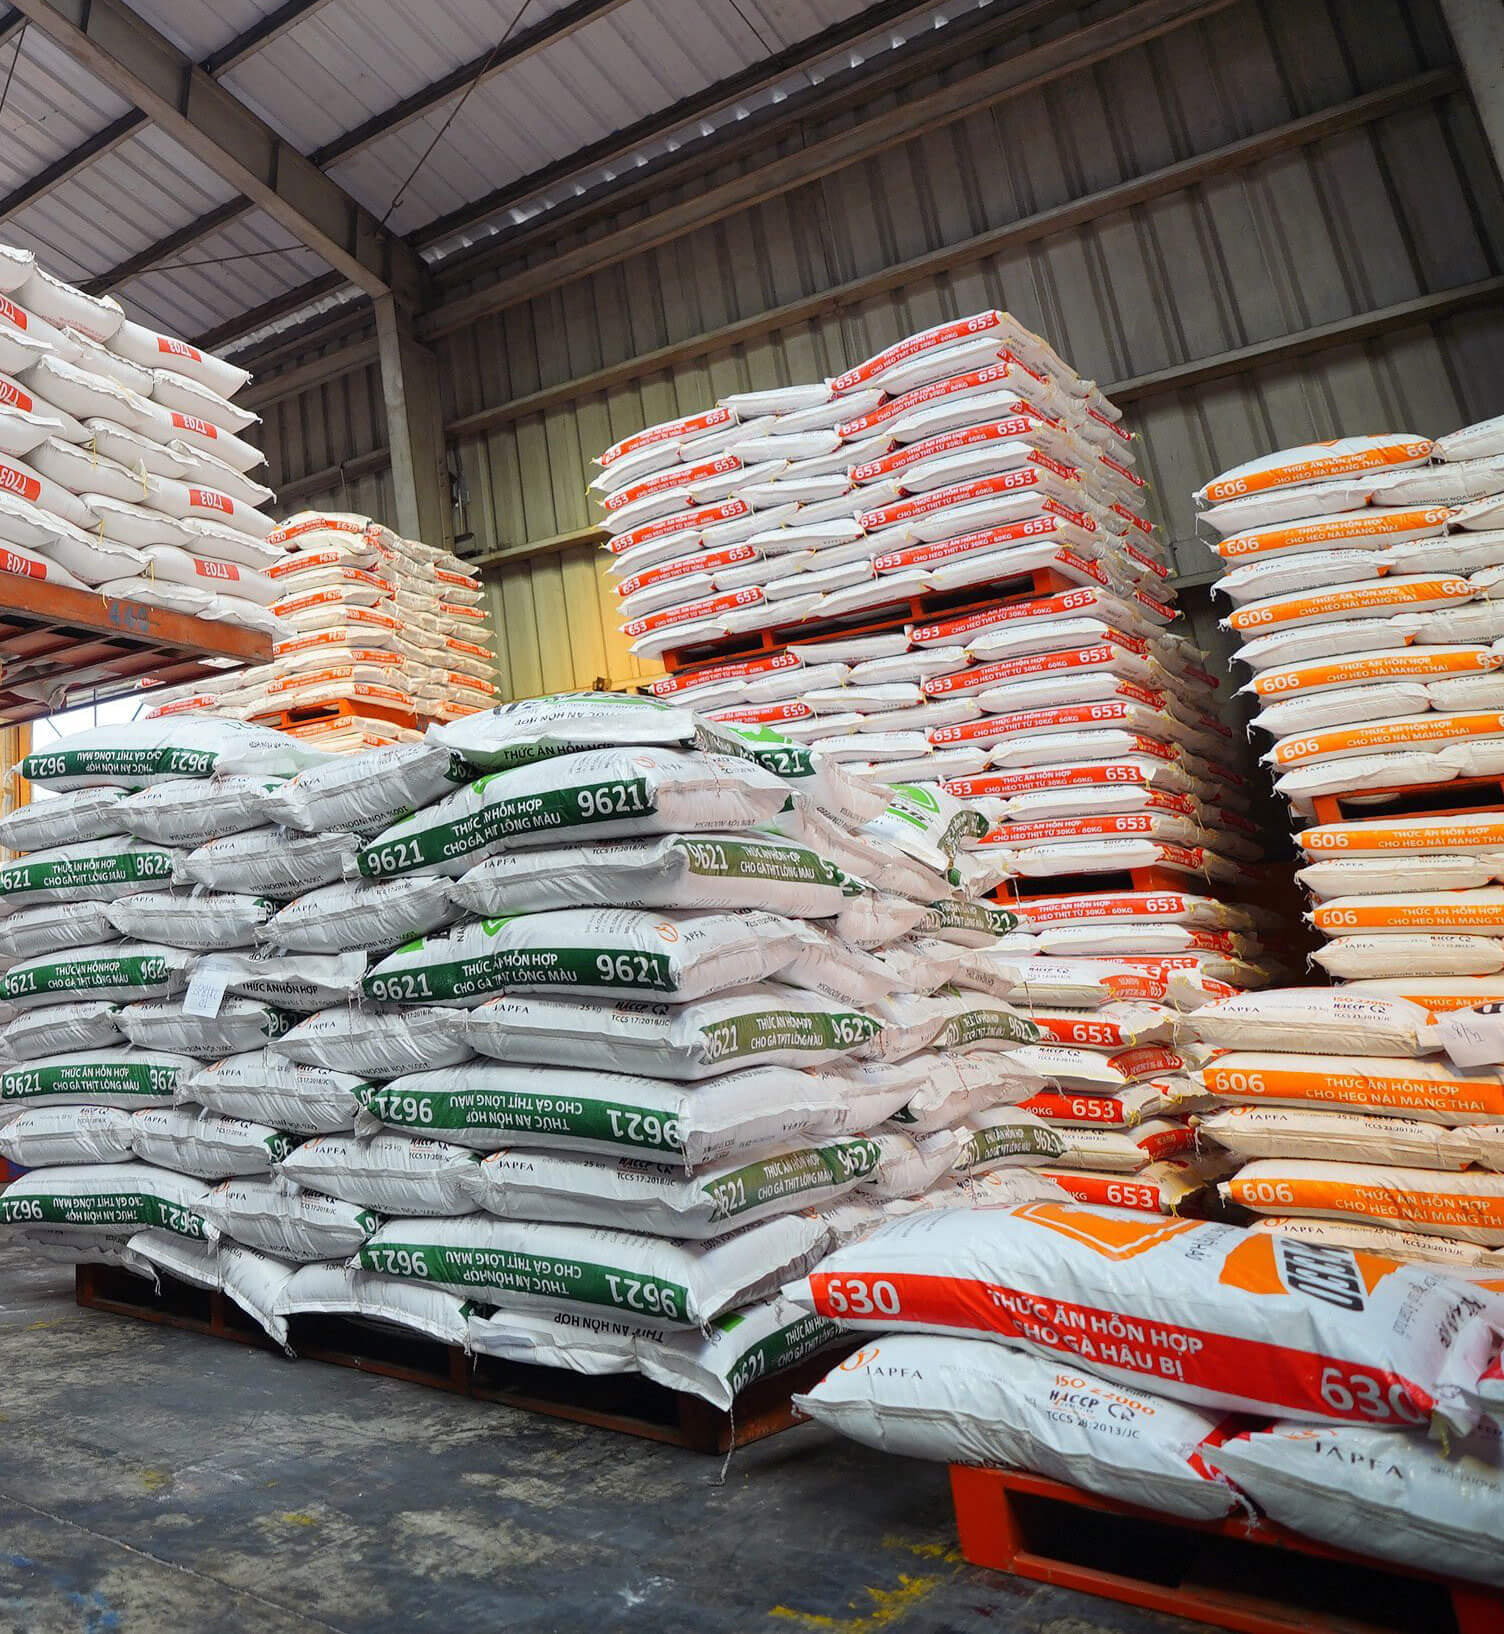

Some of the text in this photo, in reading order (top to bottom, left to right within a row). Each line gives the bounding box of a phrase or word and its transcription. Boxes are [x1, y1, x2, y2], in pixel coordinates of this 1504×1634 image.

[968, 316, 993, 331] 653
[169, 342, 191, 357] T703
[836, 373, 861, 389] 653
[184, 415, 207, 434] T703
[998, 420, 1026, 435] 653
[714, 458, 736, 471] 653
[856, 463, 882, 478] 653
[1005, 473, 1033, 487] 653
[1214, 479, 1247, 498] 606
[201, 491, 223, 510] T703
[609, 494, 628, 508] 653
[721, 503, 743, 516] 653
[1024, 519, 1053, 534] 653
[729, 546, 751, 560] 653
[1227, 537, 1259, 555] 606
[875, 555, 901, 568] 653
[205, 562, 228, 578] T703
[736, 590, 758, 603] 653
[1063, 591, 1093, 608] 653
[1238, 609, 1273, 625] 606
[772, 654, 795, 667] 653
[1080, 648, 1108, 663] 653
[655, 680, 677, 693] 653
[925, 680, 952, 693] 653
[1263, 675, 1300, 692] 606
[782, 705, 805, 717] 653
[1092, 705, 1122, 718] 653
[934, 729, 961, 741] 653
[1283, 740, 1320, 759] 606
[29, 756, 66, 775] 9621
[170, 752, 208, 773] 9621
[1106, 768, 1138, 780] 653
[577, 783, 645, 818] 9621
[1116, 817, 1146, 830] 653
[1310, 833, 1348, 847] 606
[368, 839, 425, 876] 9621
[1147, 899, 1178, 912] 653
[1323, 911, 1357, 924] 606
[462, 960, 492, 977] THỨC
[595, 953, 666, 987] 9621
[372, 973, 433, 1000] 9621
[453, 980, 476, 995] CHO
[1073, 1025, 1114, 1043] 653
[61, 1068, 80, 1078] THỨC
[150, 1069, 176, 1090] 962
[5, 1073, 42, 1095] 9621
[53, 1081, 68, 1091] CHO
[1215, 1072, 1264, 1093] 606
[1326, 1078, 1362, 1089] THỨC
[556, 1099, 583, 1116] CHO
[1306, 1089, 1334, 1099] CHO
[1339, 1091, 1367, 1101] HEO
[1400, 1097, 1445, 1108] MANG
[1450, 1100, 1485, 1111] THAI
[376, 1096, 433, 1123] 9621
[1072, 1100, 1115, 1118] 653
[536, 1114, 570, 1130] THỨC
[606, 1108, 680, 1149] 9621
[1107, 1185, 1153, 1207] 653
[1243, 1182, 1294, 1203] 606
[3, 1199, 43, 1221] 9621
[368, 1250, 429, 1277] 9621
[554, 1261, 582, 1279] CHO
[605, 1273, 678, 1318] 9621
[828, 1279, 901, 1314] 630
[987, 1288, 1204, 1359] THỨC ĂN HỖN HỢP
[1013, 1319, 1185, 1381] CHO GÀ HẬU BỊ
[867, 1366, 923, 1379] JAPFA
[1056, 1376, 1087, 1388] ISO
[1050, 1390, 1100, 1408] HACCP
[1047, 1411, 1072, 1423] TCCS
